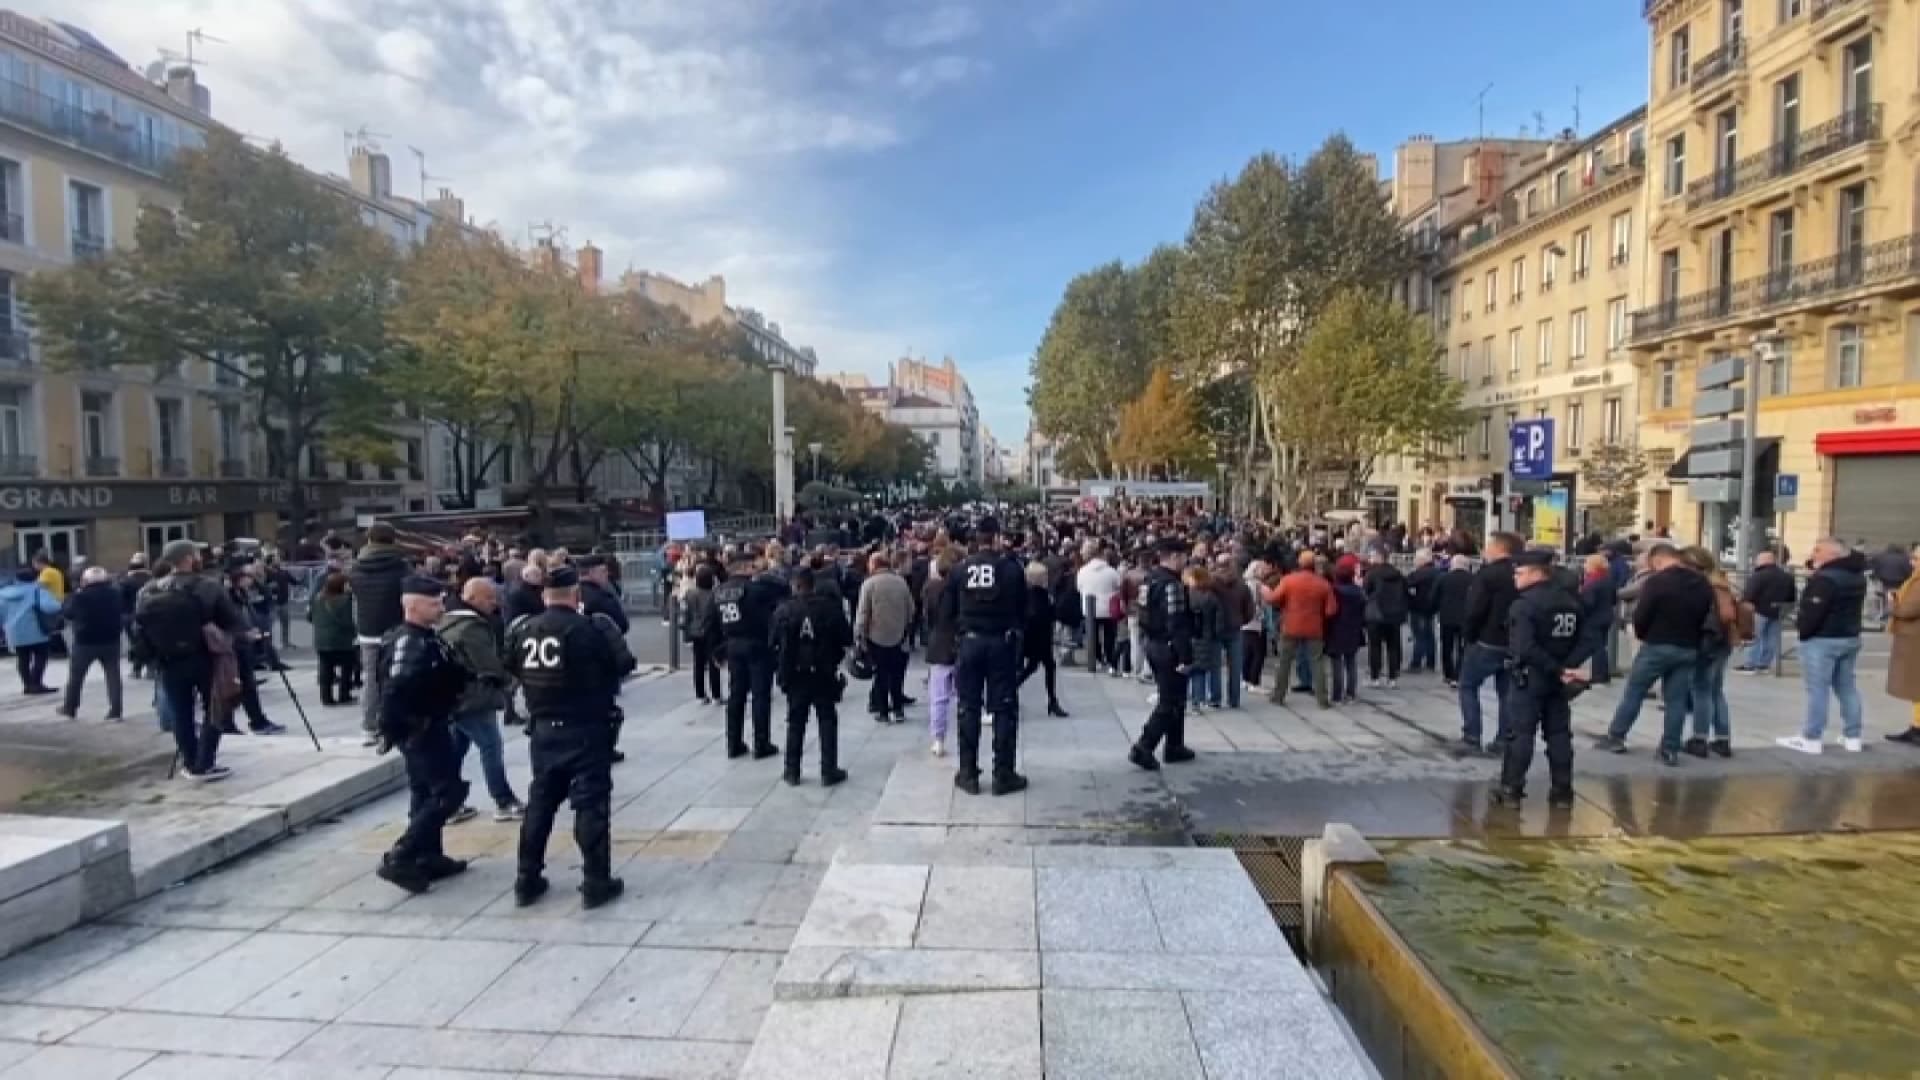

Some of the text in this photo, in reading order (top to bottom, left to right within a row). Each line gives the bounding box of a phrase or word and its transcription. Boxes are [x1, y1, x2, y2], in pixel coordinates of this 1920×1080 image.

[1530, 425, 1545, 460] P
[0, 486, 113, 510] GRAND
[170, 486, 217, 505] BAR
[967, 564, 995, 588] 2B
[720, 602, 741, 623] 2B
[1552, 612, 1577, 637] 2B
[800, 616, 814, 639] A
[522, 636, 561, 669] 2C
